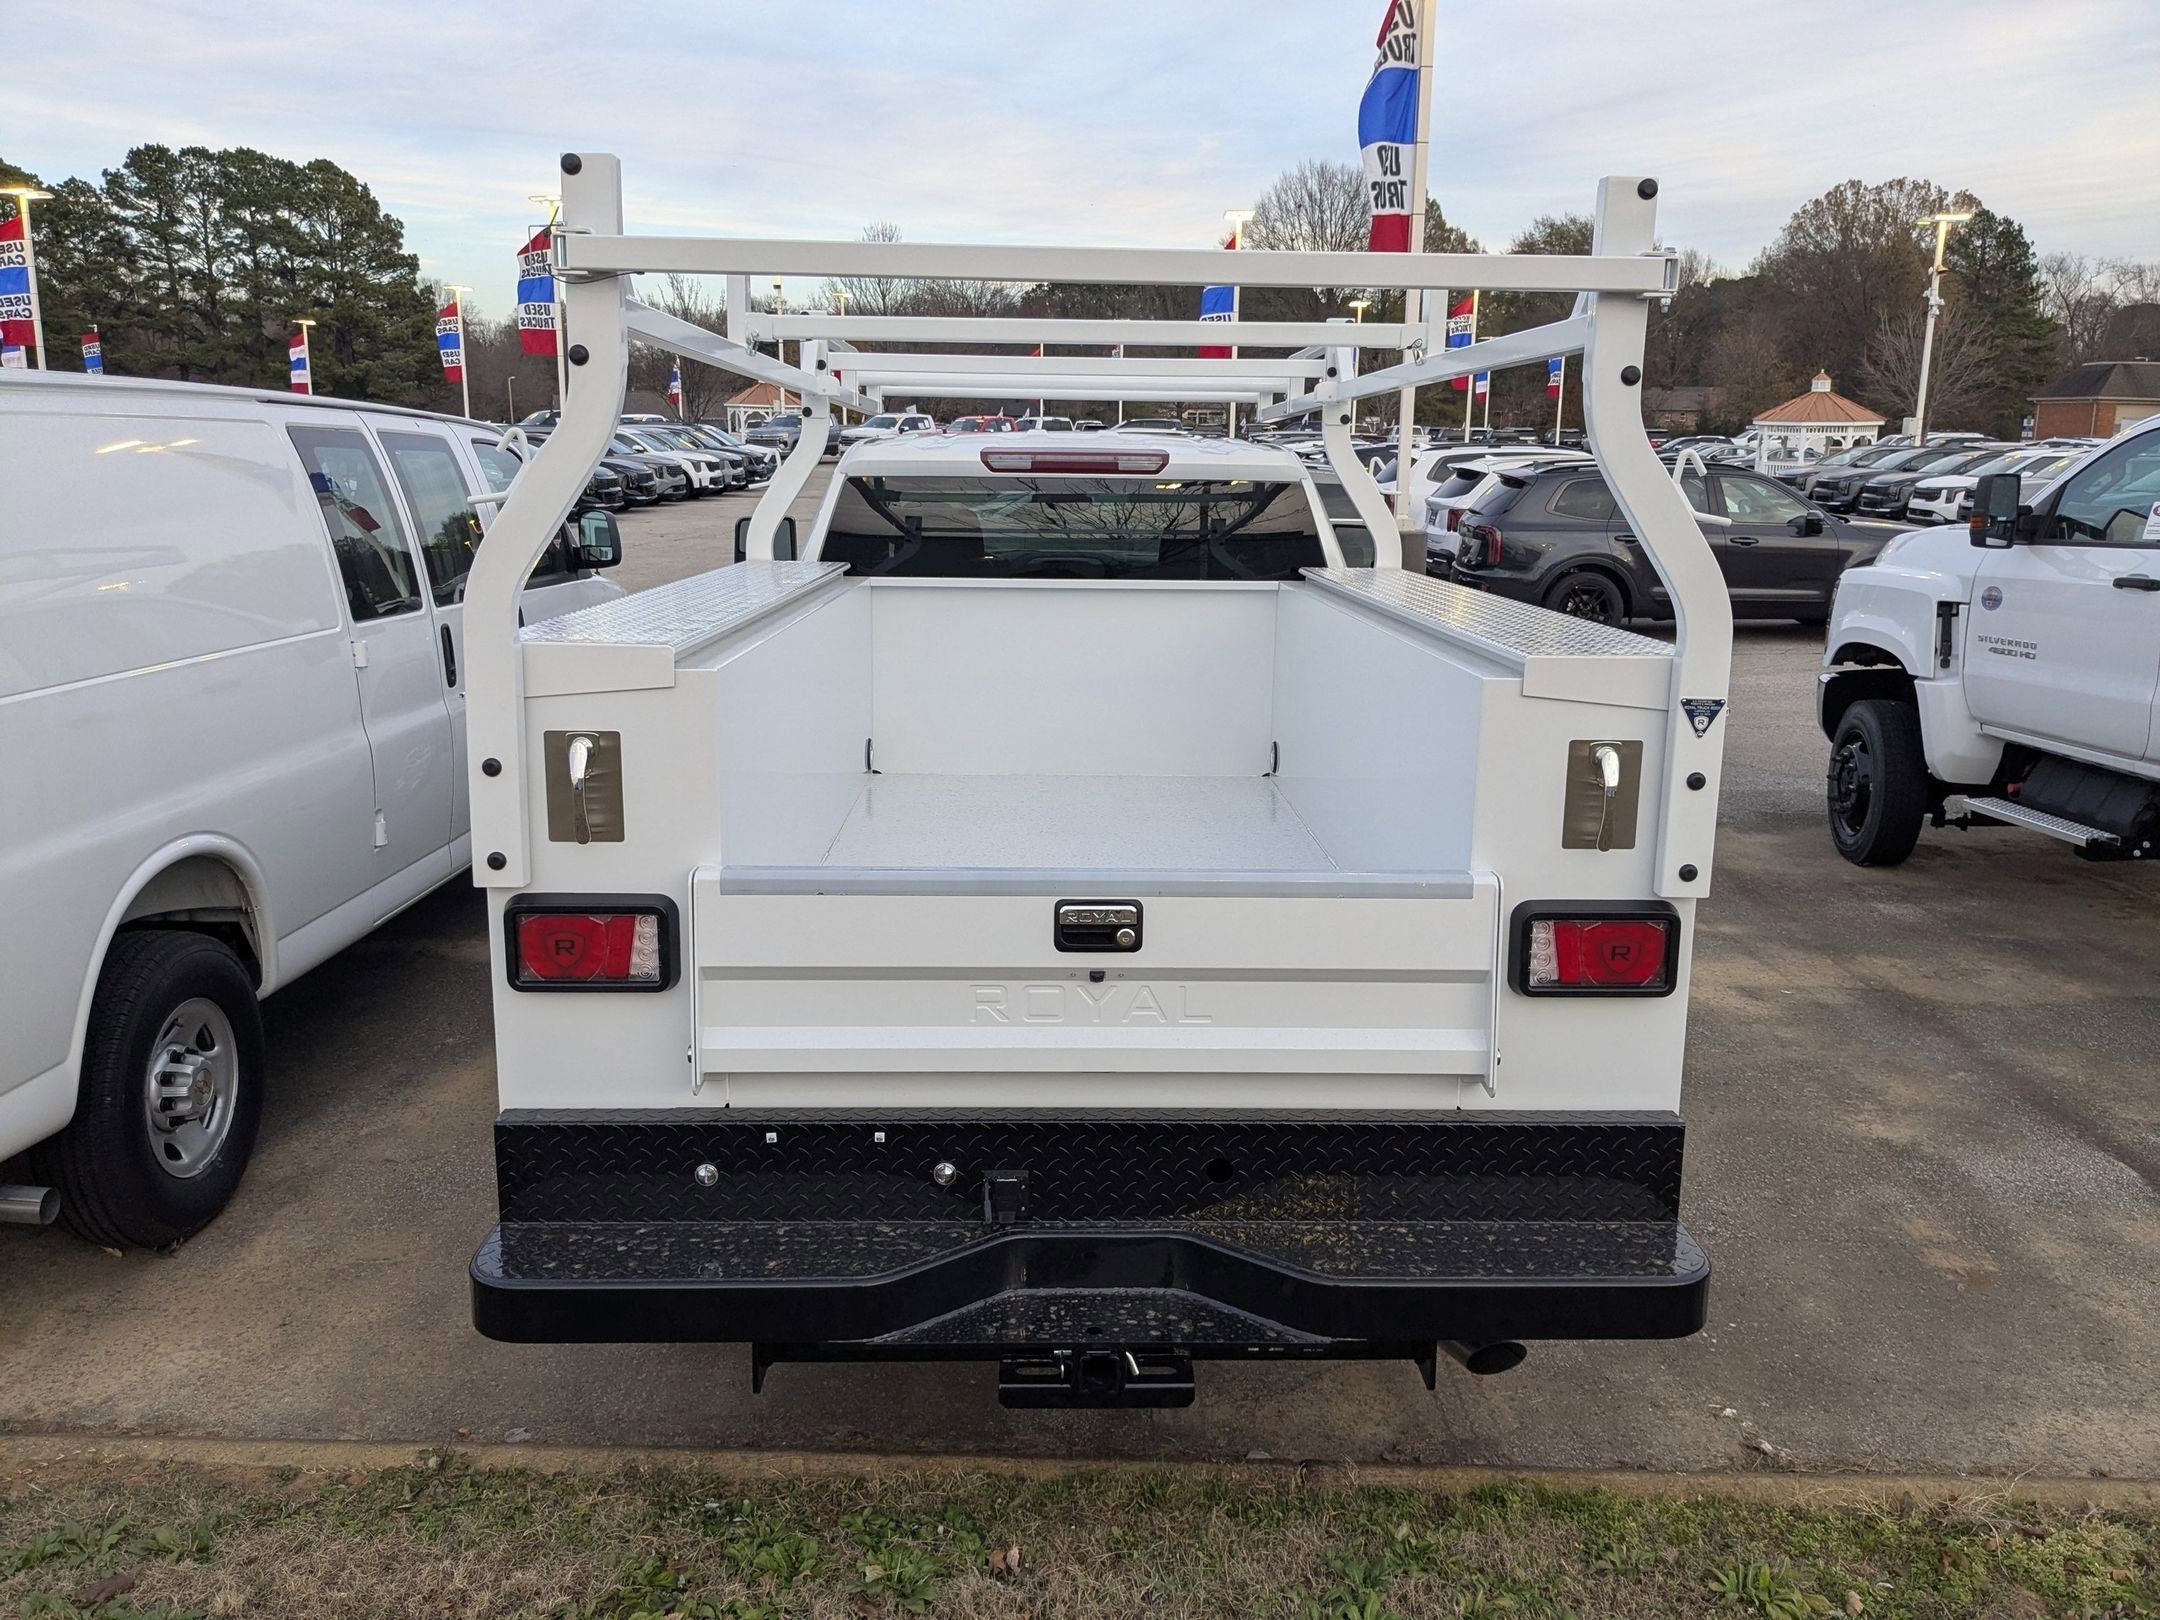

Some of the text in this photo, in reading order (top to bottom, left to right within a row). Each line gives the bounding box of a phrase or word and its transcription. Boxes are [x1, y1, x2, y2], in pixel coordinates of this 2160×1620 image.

[1977, 634, 2037, 651] SILVERADO
[1065, 911, 1132, 923] ROYAL
[554, 939, 577, 957] R
[1610, 945, 1632, 961] R
[969, 984, 1213, 1024] ROYAL
